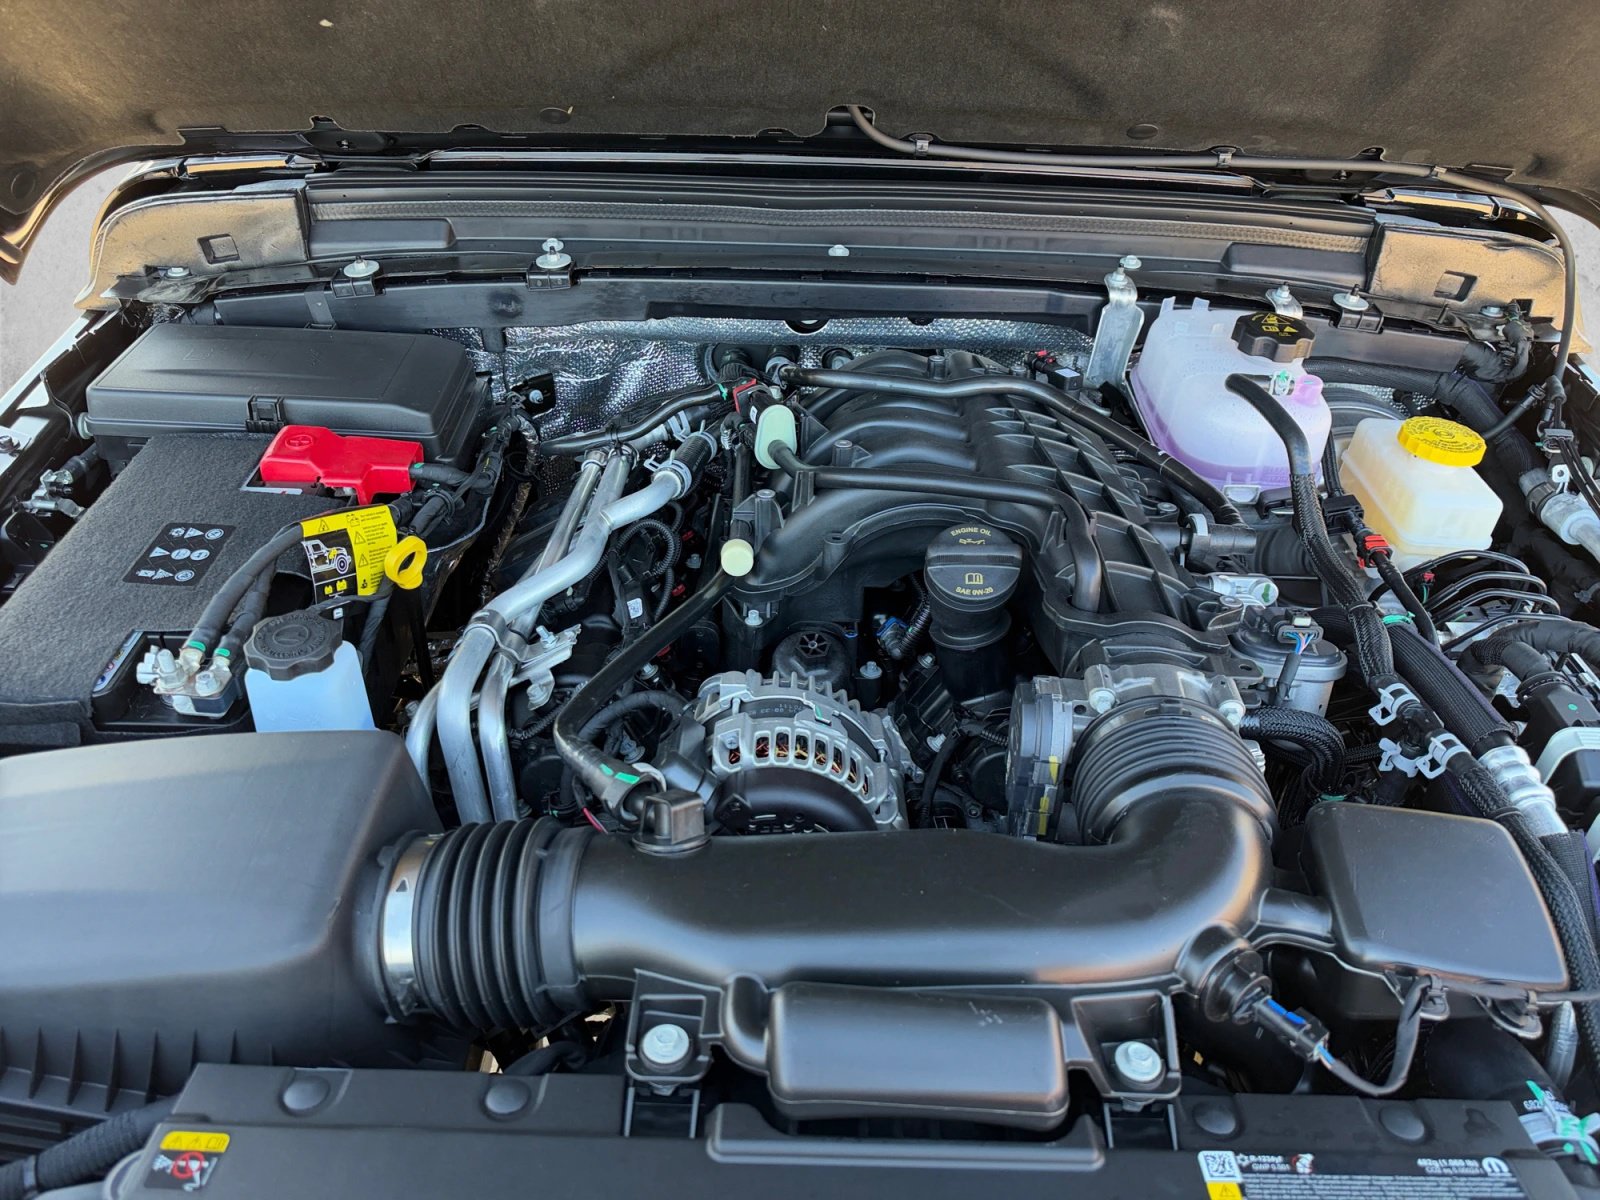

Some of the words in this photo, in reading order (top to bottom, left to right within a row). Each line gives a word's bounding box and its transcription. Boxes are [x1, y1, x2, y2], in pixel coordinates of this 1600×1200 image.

[951, 527, 978, 537] ENGINE
[980, 528, 991, 536] OIL
[956, 587, 971, 595] SAE
[972, 587, 994, 595] 0W-20
